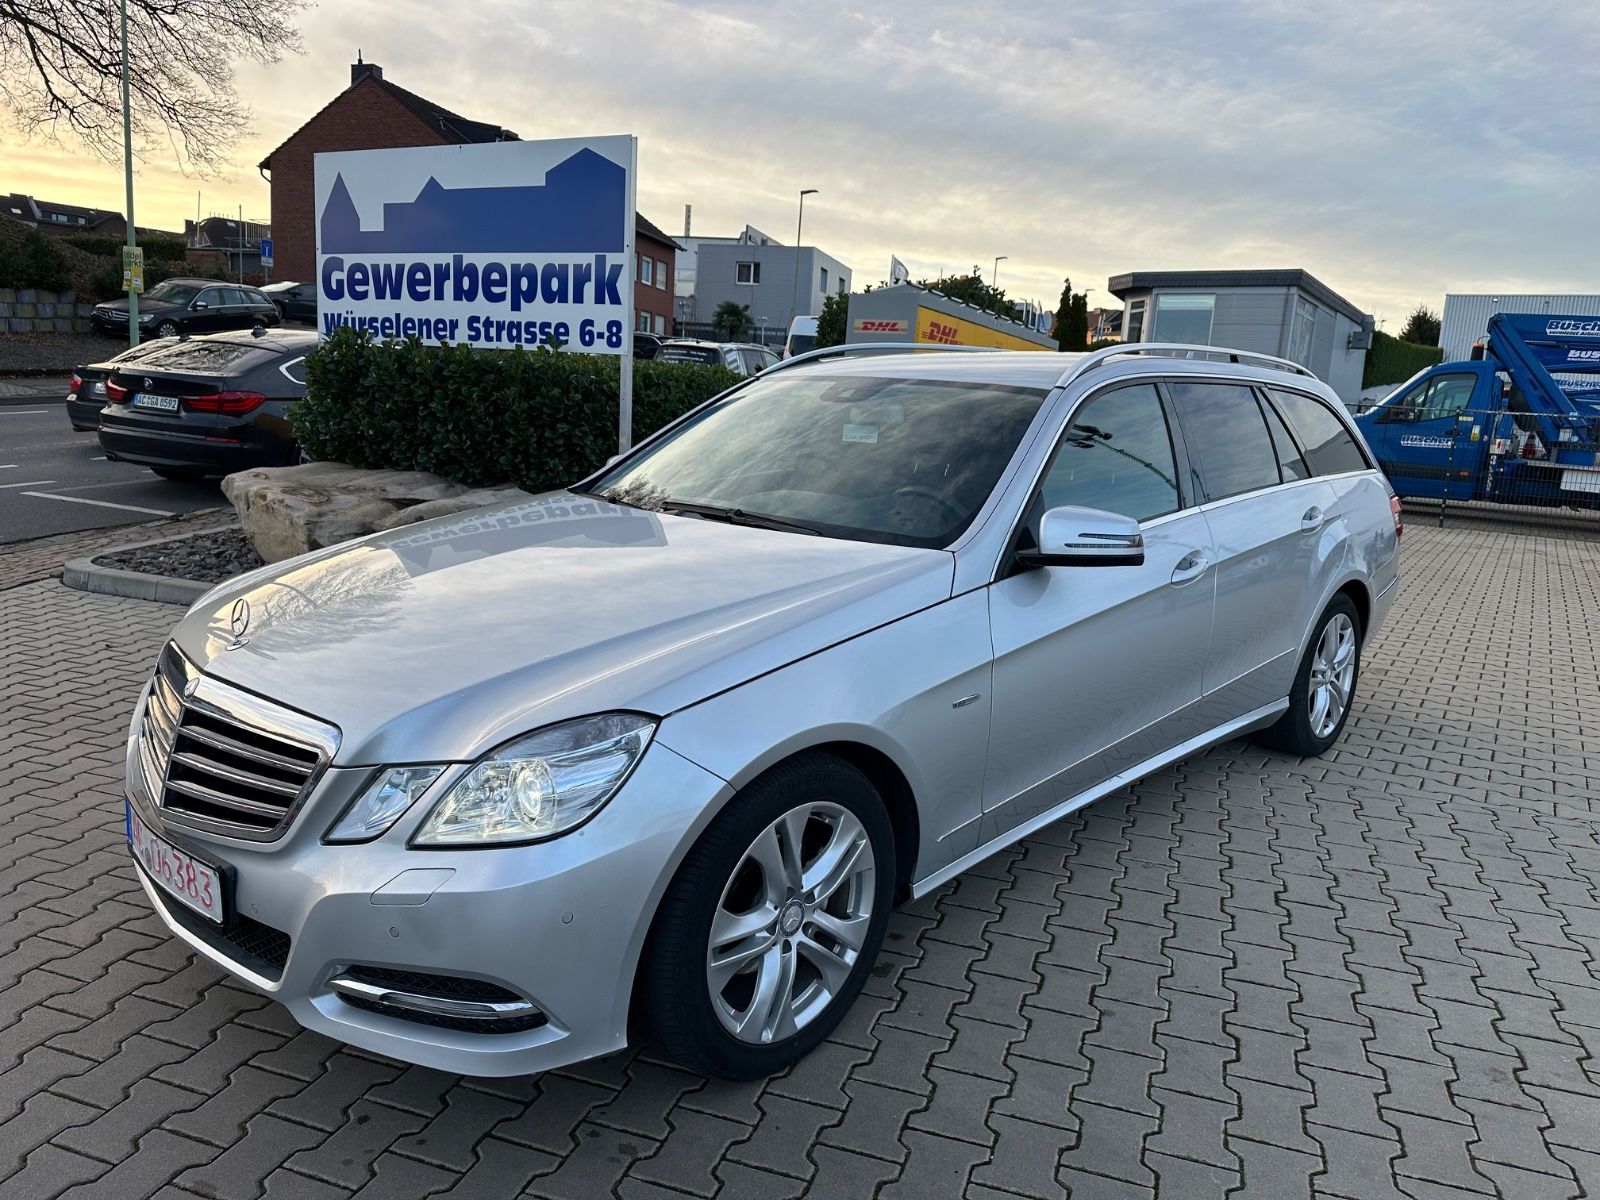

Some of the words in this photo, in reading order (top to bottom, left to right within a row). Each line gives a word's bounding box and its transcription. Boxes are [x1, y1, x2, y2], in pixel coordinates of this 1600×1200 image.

[321, 254, 623, 311] Gewerbepark
[323, 310, 459, 342] Würselener
[466, 315, 570, 345] Strasse
[578, 318, 623, 348] 6-8
[861, 321, 900, 332] DHL
[159, 397, 177, 409] 8592
